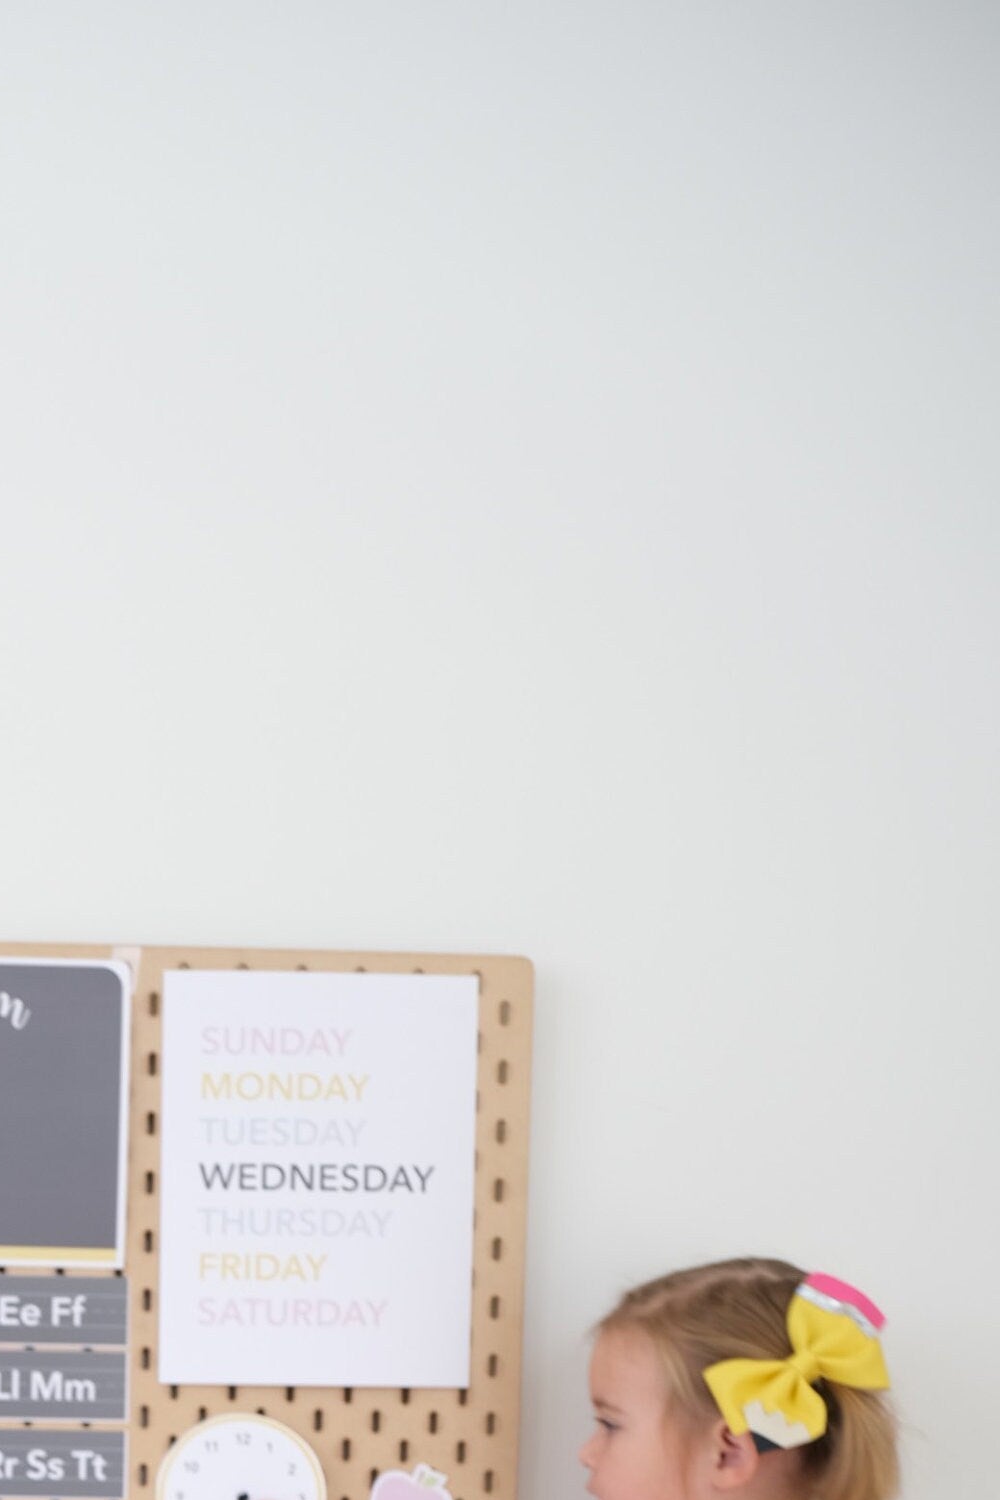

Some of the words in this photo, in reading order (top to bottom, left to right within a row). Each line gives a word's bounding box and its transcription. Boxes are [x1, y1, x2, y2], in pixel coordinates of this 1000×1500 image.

[203, 1027, 352, 1057] SUNDAY
[200, 1072, 369, 1102] MONDAY
[199, 1117, 366, 1148] TUESDAY
[199, 1162, 436, 1193] WEDNESDAY
[199, 1207, 394, 1239] THURSDAY
[198, 1252, 328, 1283] FRIDAY
[50, 1295, 87, 1327] Ff
[198, 1297, 387, 1329] SATURDAY
[30, 1370, 96, 1402] Mm
[235, 1432, 252, 1446] 12
[26, 1449, 65, 1481] Ss
[72, 1451, 106, 1480] Tt
